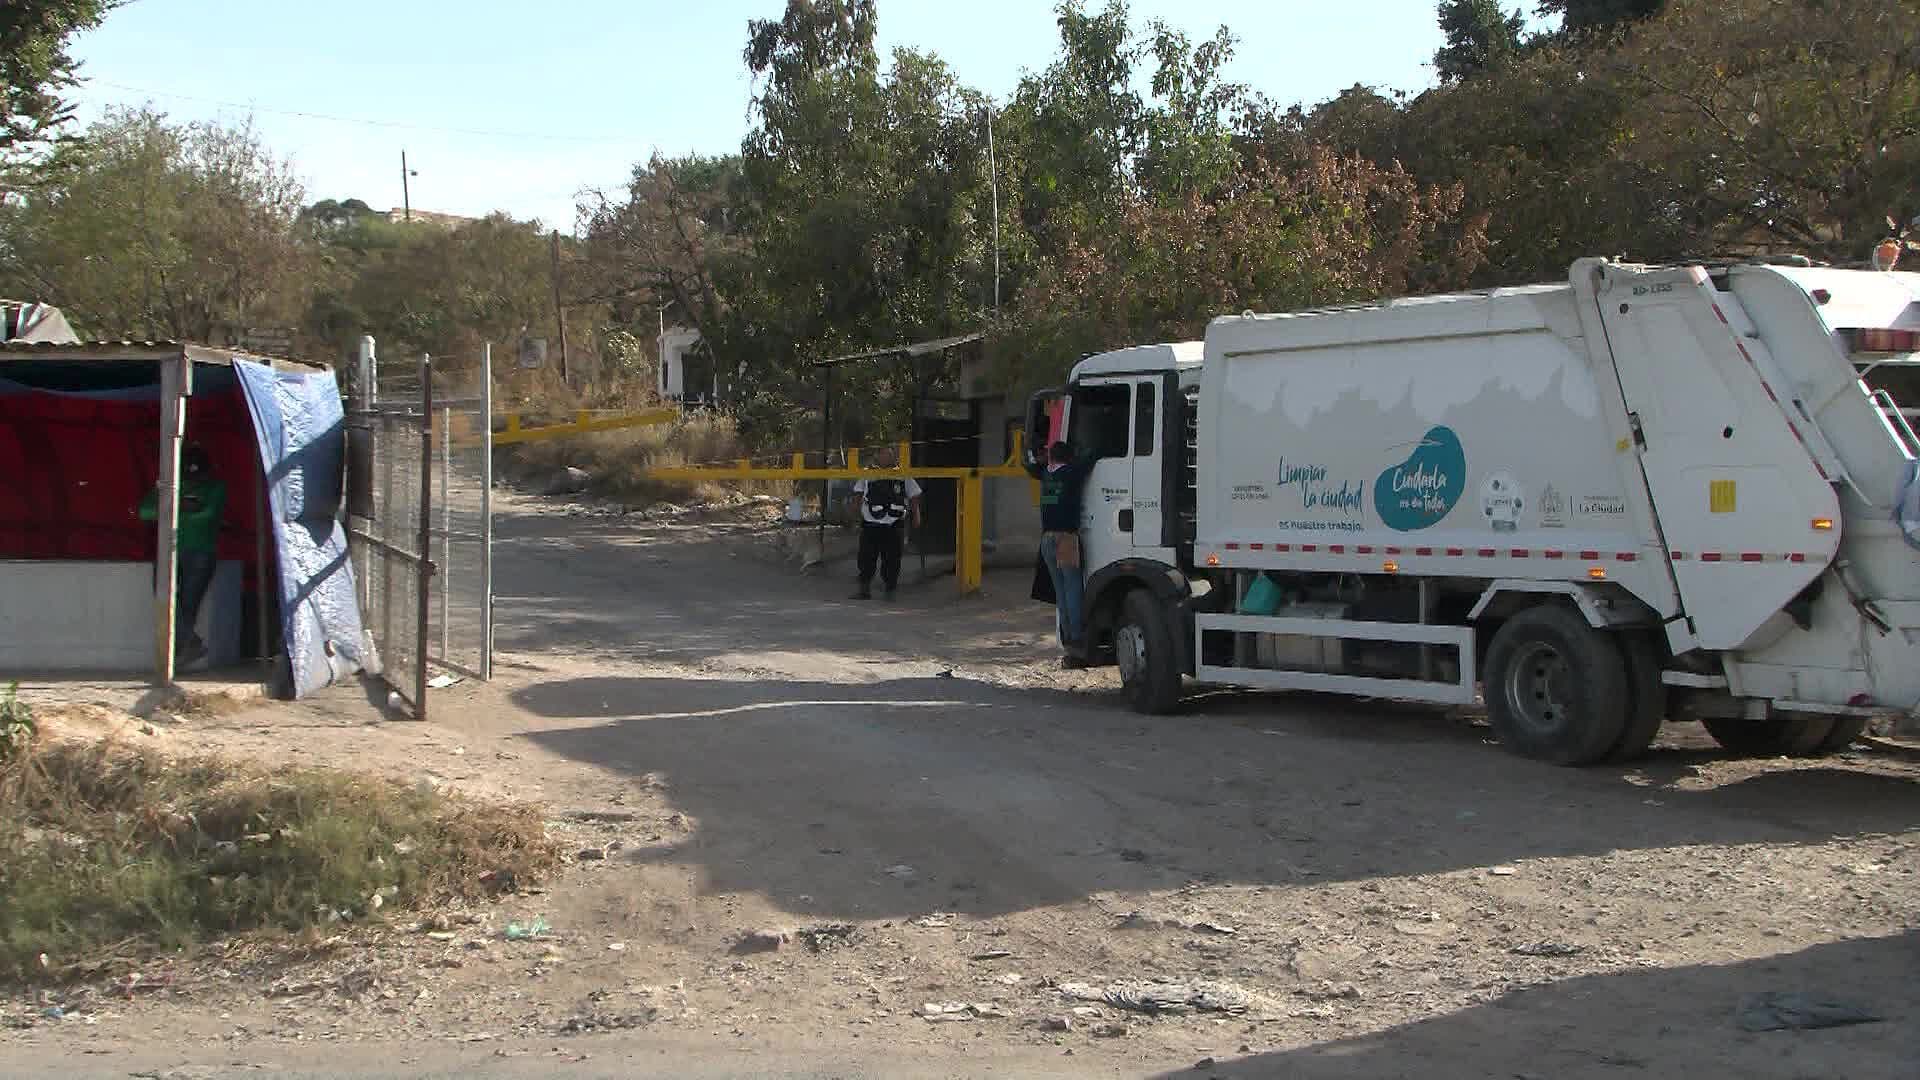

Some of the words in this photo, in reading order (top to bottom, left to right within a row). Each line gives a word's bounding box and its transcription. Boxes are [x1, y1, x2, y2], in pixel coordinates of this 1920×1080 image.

[1277, 455, 1328, 489] Limpiar
[1392, 461, 1447, 495] Cuidarla
[1303, 481, 1317, 509] La
[1321, 480, 1364, 516] ciudad
[1591, 502, 1625, 513] Ciudad
[1291, 520, 1326, 531] nuestro
